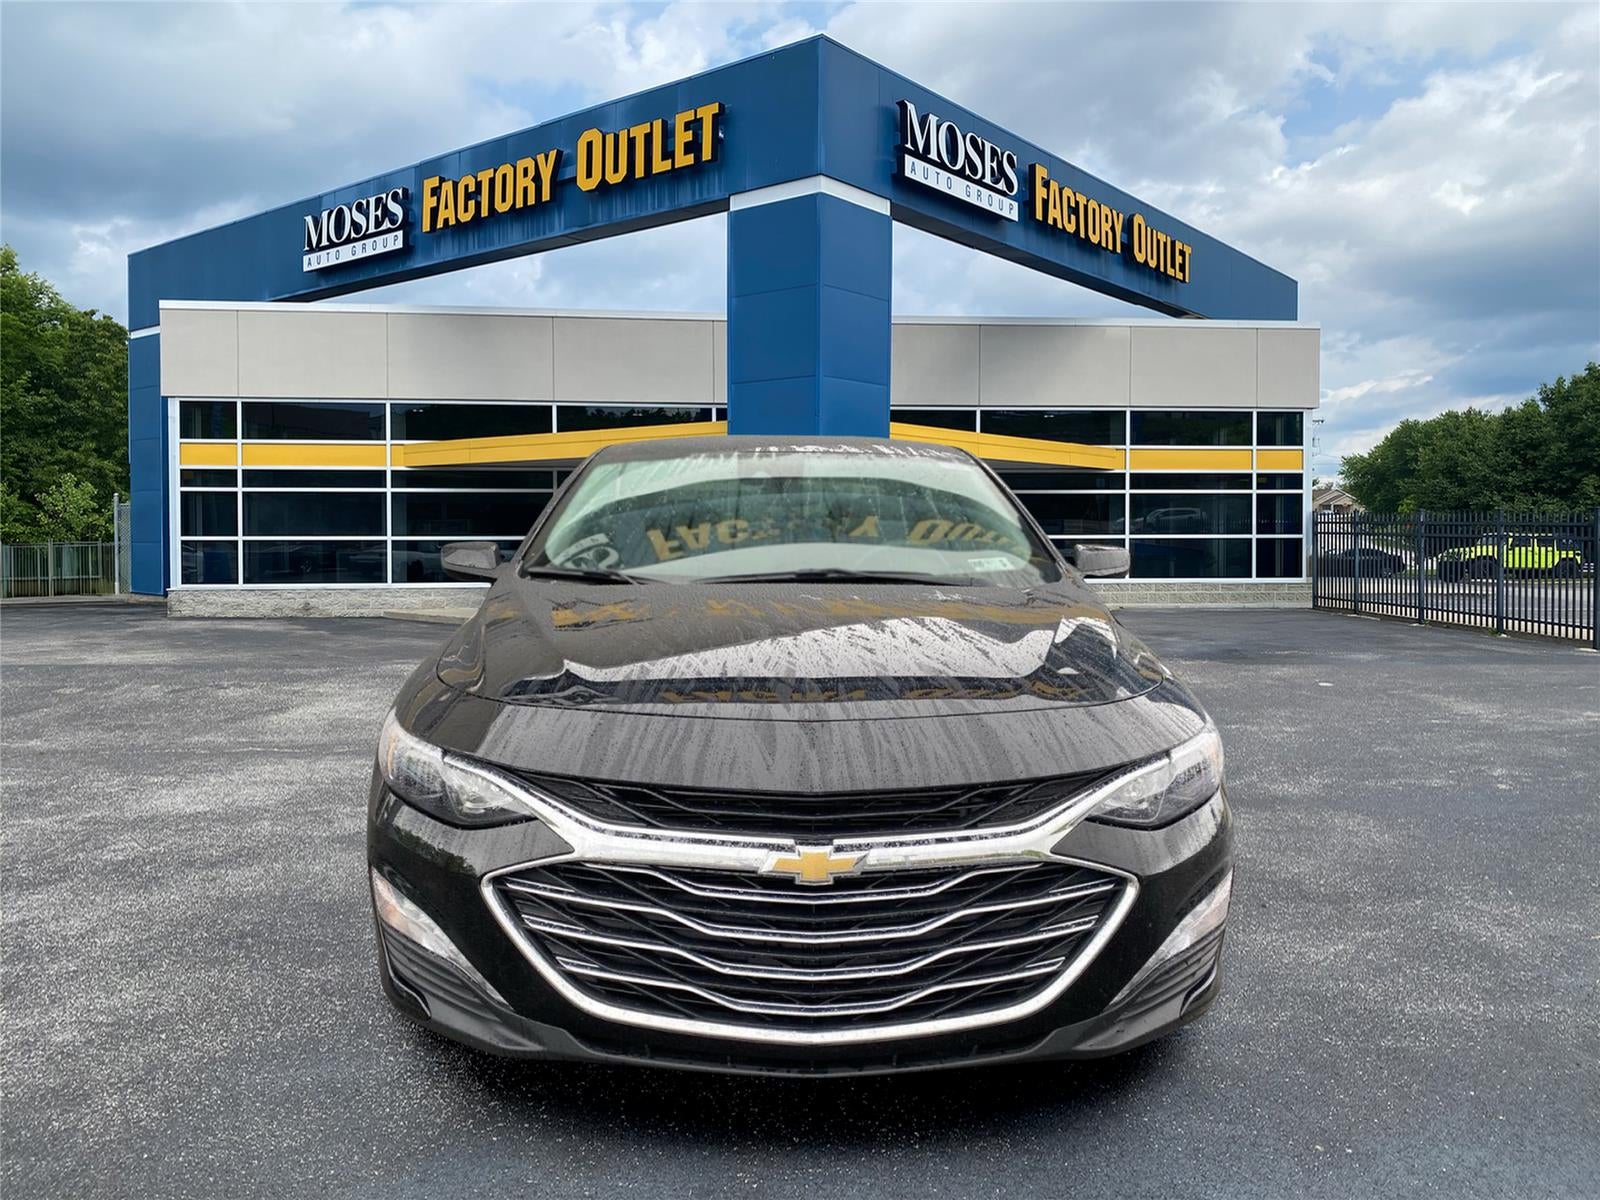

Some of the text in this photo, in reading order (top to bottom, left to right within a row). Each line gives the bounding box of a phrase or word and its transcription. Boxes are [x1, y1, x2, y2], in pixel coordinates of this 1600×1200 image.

[422, 101, 719, 233] FACTORY OUTLET
[903, 99, 1018, 196] MOSES
[303, 187, 404, 251] MOSES
[910, 161, 1015, 215] AUTO GROUP
[1035, 163, 1192, 283] FACTORY OUTLET
[307, 234, 400, 268] AUTO GROUP
